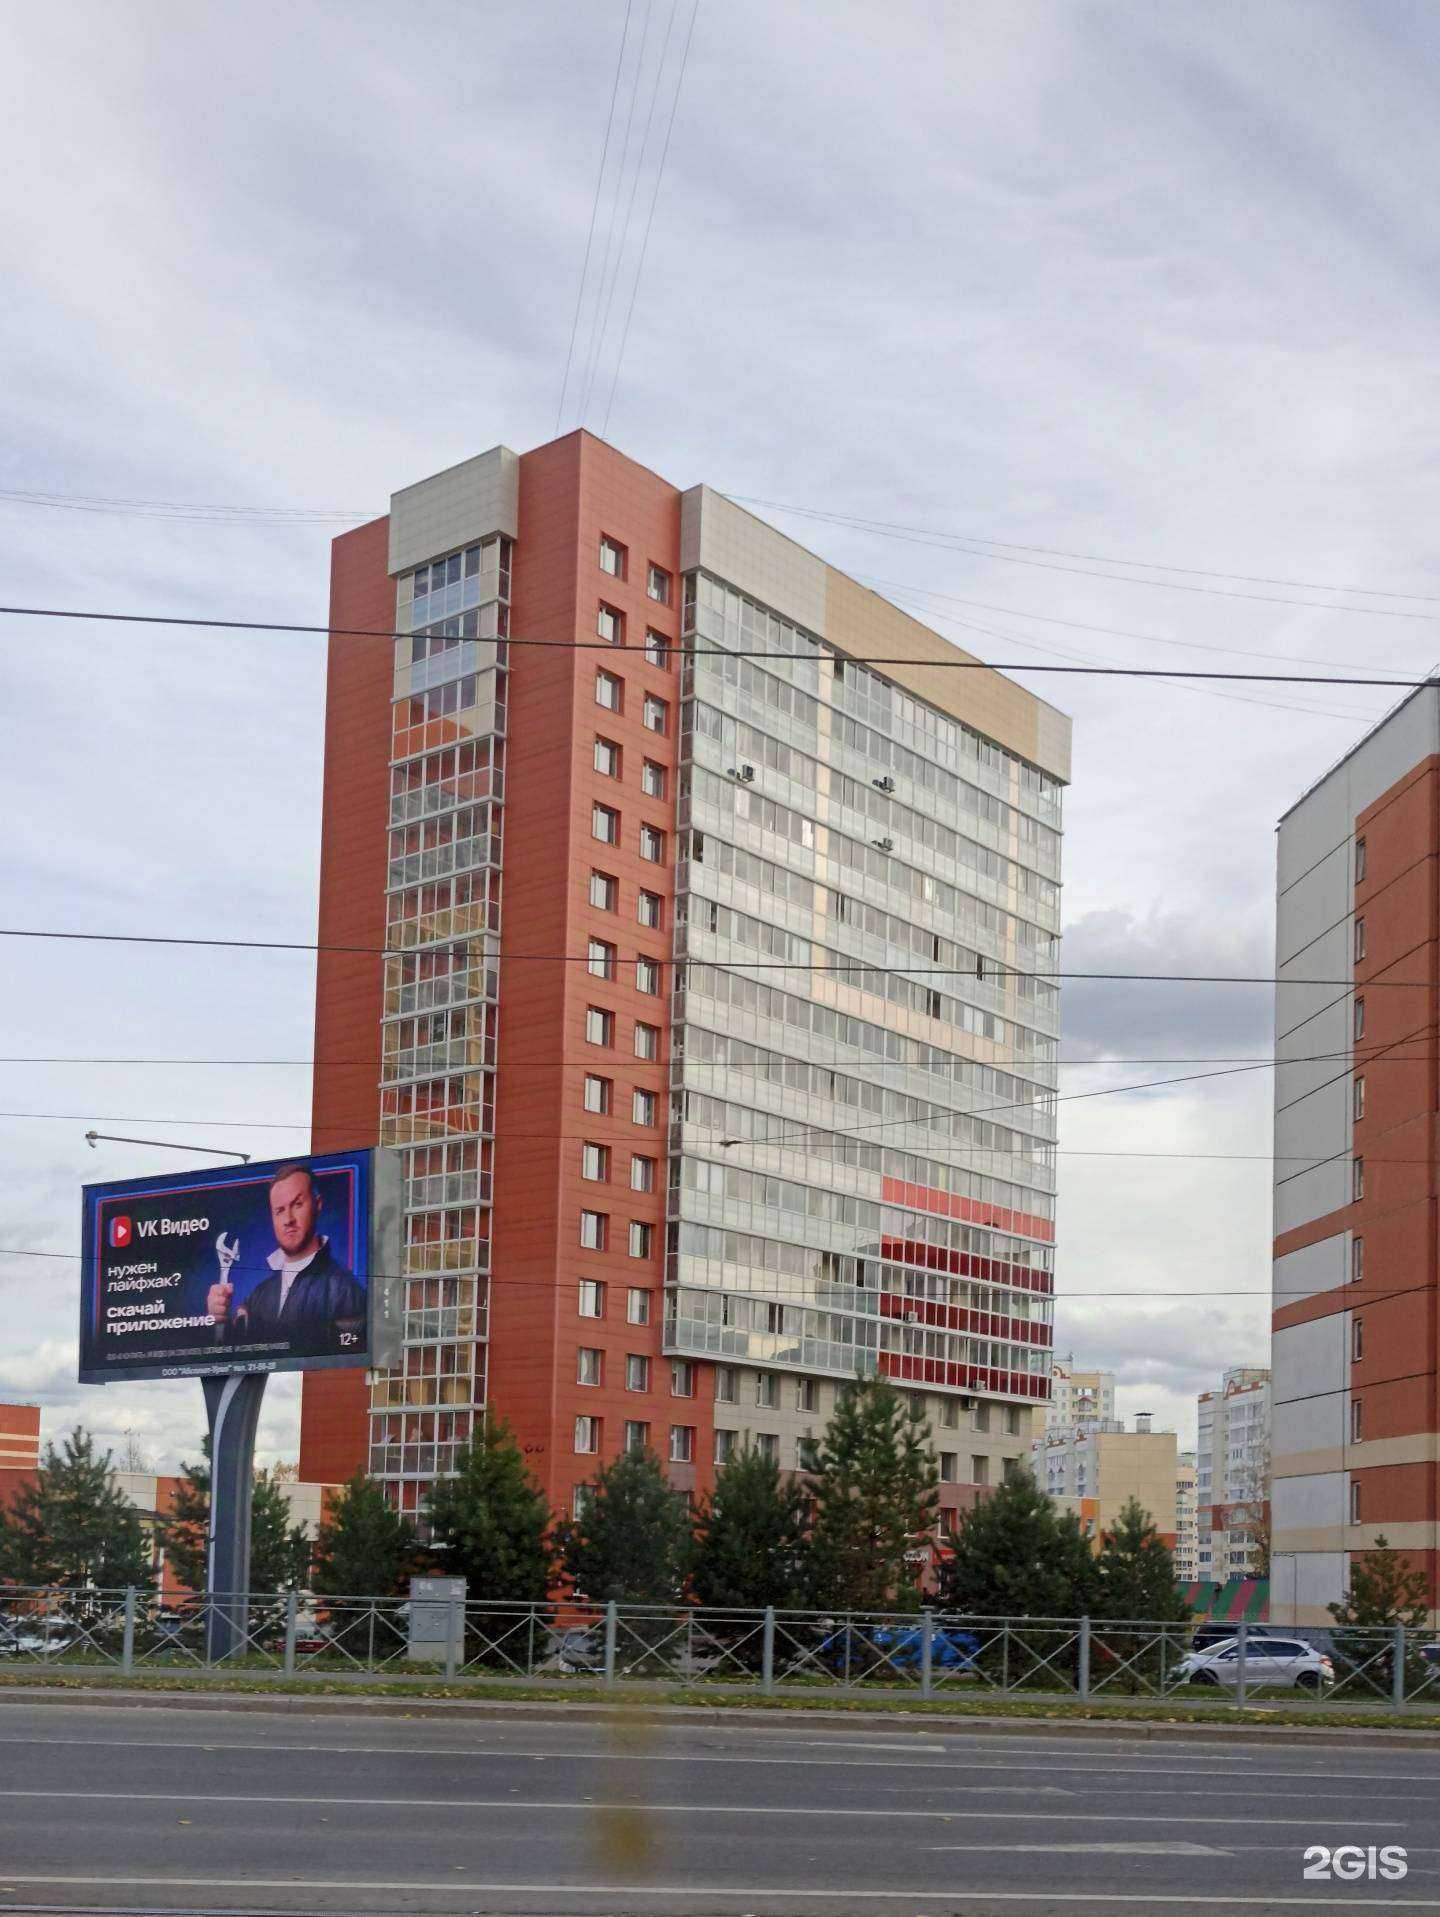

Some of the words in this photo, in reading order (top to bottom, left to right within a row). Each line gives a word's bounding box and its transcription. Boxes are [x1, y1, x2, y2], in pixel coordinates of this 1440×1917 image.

[138, 1220, 158, 1238] VK
[161, 1218, 210, 1236] Видео
[108, 1262, 158, 1279] нужен
[107, 1273, 182, 1292] лайфхак?
[106, 1299, 165, 1318] скачай
[106, 1315, 215, 1336] приложение
[339, 1332, 359, 1346] 12+
